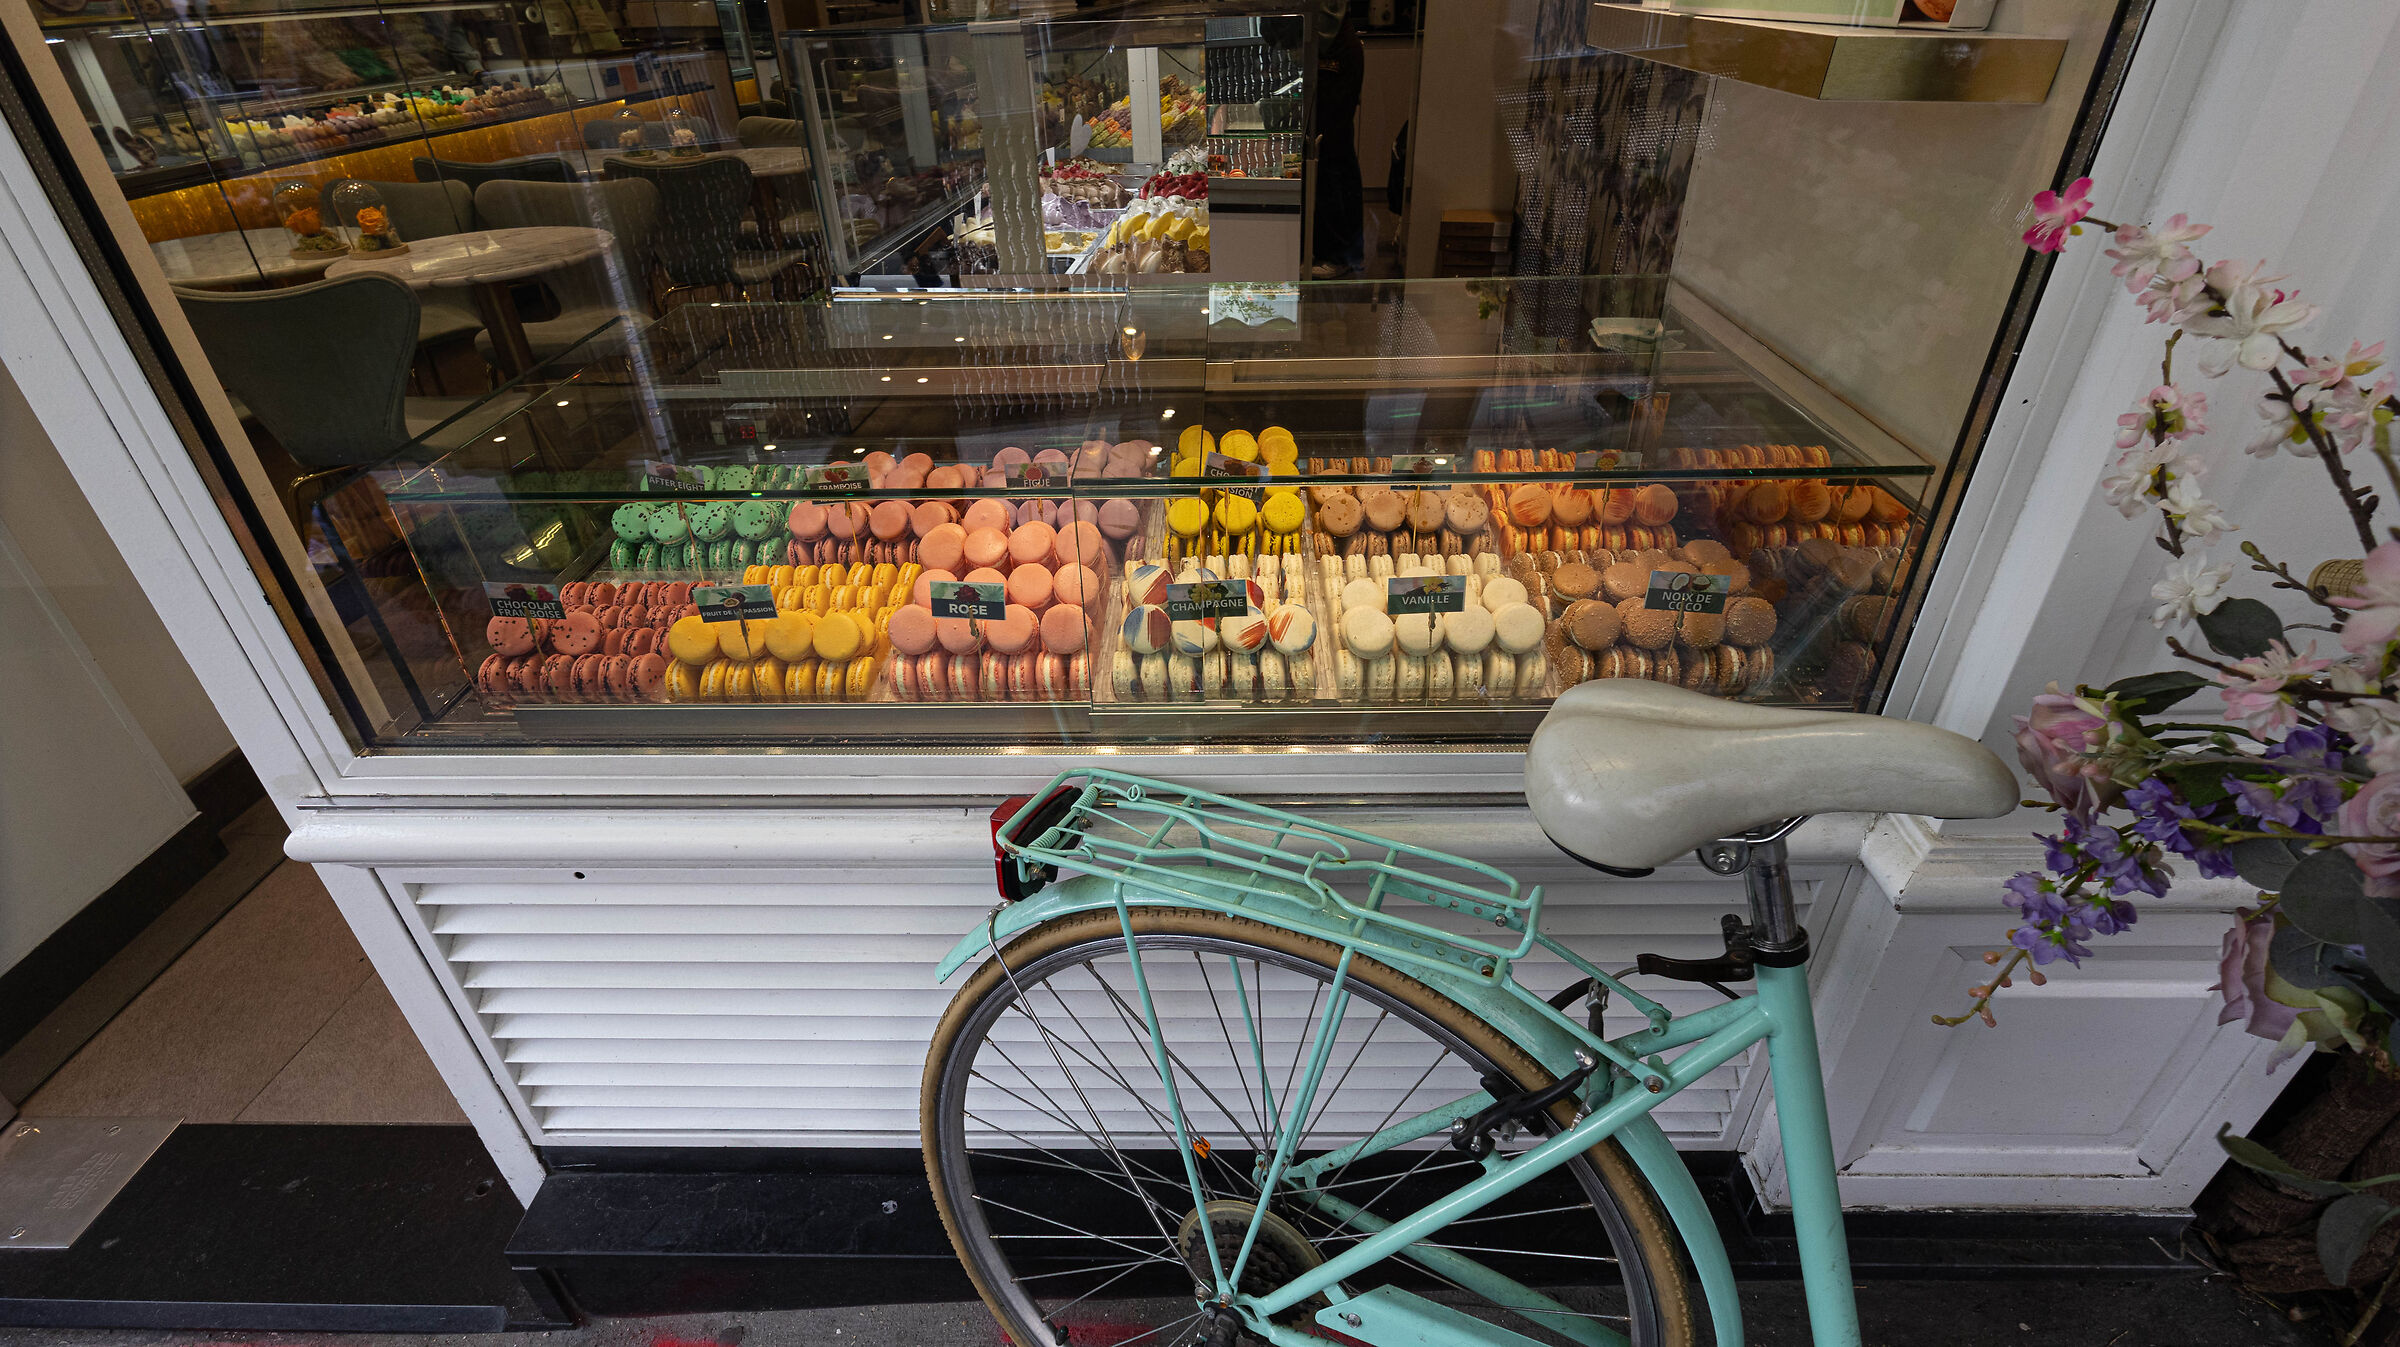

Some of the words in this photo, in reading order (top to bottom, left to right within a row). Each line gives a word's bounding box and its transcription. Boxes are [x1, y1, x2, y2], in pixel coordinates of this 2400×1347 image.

[648, 476, 676, 488] AFTER
[678, 481, 705, 491] EIGHT
[1401, 595, 1449, 605] VANILLE
[1662, 591, 1694, 602] NOIX
[1696, 594, 1712, 603] DE
[496, 600, 557, 611] CHOCOLAT
[743, 606, 774, 614] PASSION
[948, 603, 988, 615] ROSE
[1171, 598, 1244, 612] CHAMPAGNE
